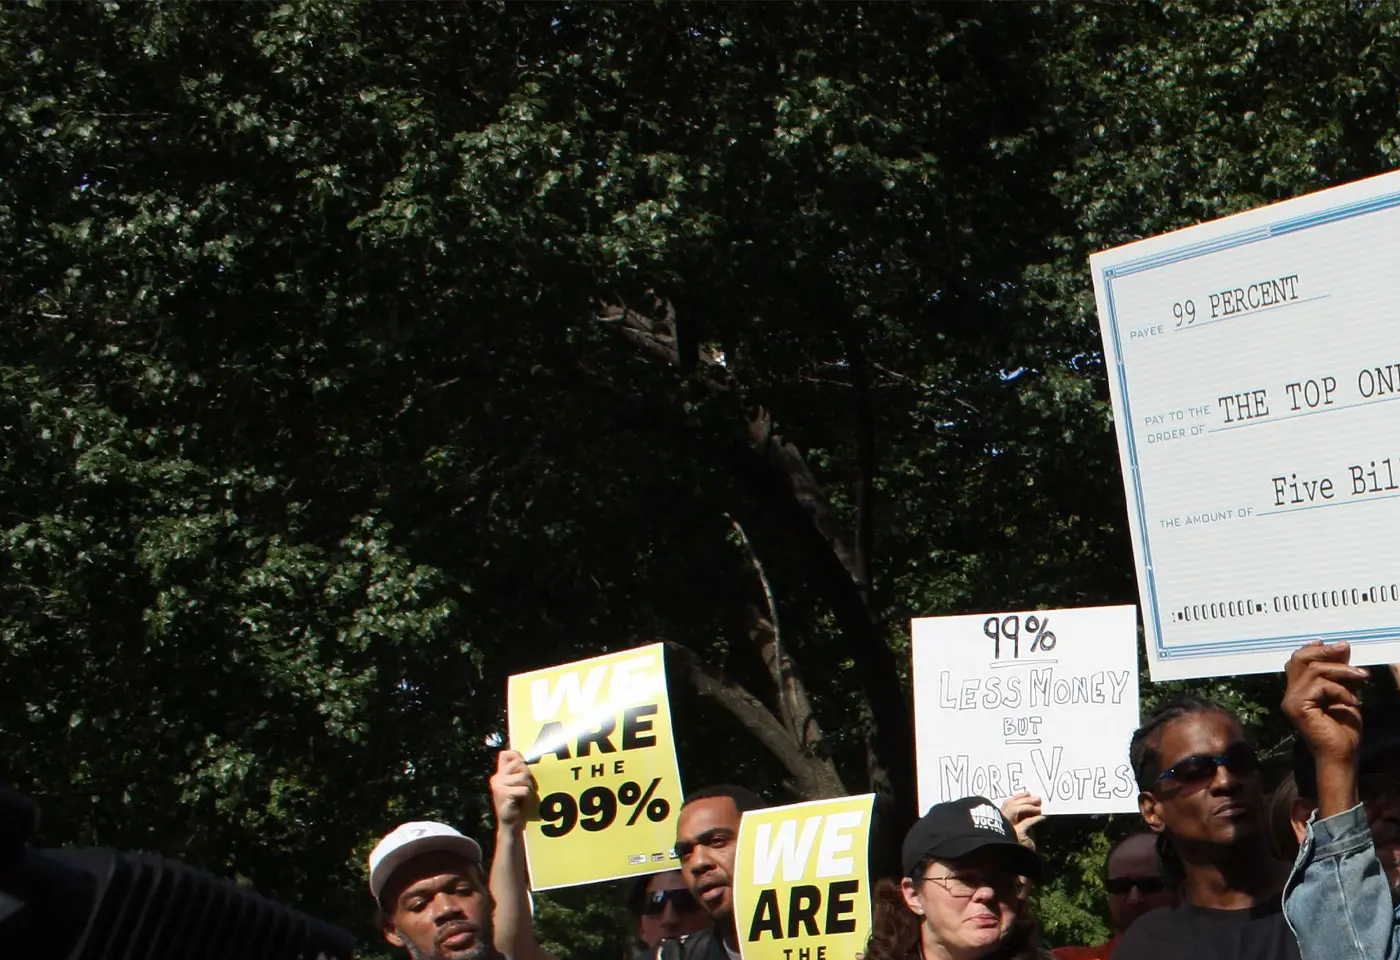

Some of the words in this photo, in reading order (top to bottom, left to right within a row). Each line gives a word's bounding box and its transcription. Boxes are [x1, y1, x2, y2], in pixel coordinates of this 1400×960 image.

[1130, 324, 1164, 340] PAYEE
[1172, 300, 1197, 327] 99
[1208, 275, 1299, 318] PERCENT
[1144, 415, 1165, 427] PAY
[1169, 410, 1184, 421] TO
[1190, 405, 1211, 417] THE
[1218, 389, 1270, 423] THE
[1286, 376, 1337, 411] TOP
[1147, 428, 1186, 444] ORDER
[1191, 424, 1206, 437] OF
[1160, 517, 1181, 529] THE
[1185, 509, 1233, 526] AMOUNT
[1238, 507, 1254, 518] OF
[1271, 473, 1335, 506] Five
[983, 615, 1057, 659] 99%
[530, 654, 656, 721] WE
[939, 670, 1022, 710] LESS
[1030, 667, 1129, 708] MONEY
[526, 703, 658, 765] ARE
[1003, 716, 1042, 736] BUT
[571, 760, 625, 781] THE
[939, 755, 1026, 803] MORE
[1030, 746, 1134, 802] VOTES
[540, 777, 670, 838] 99%
[753, 810, 865, 885] WE
[748, 879, 859, 942] ARE
